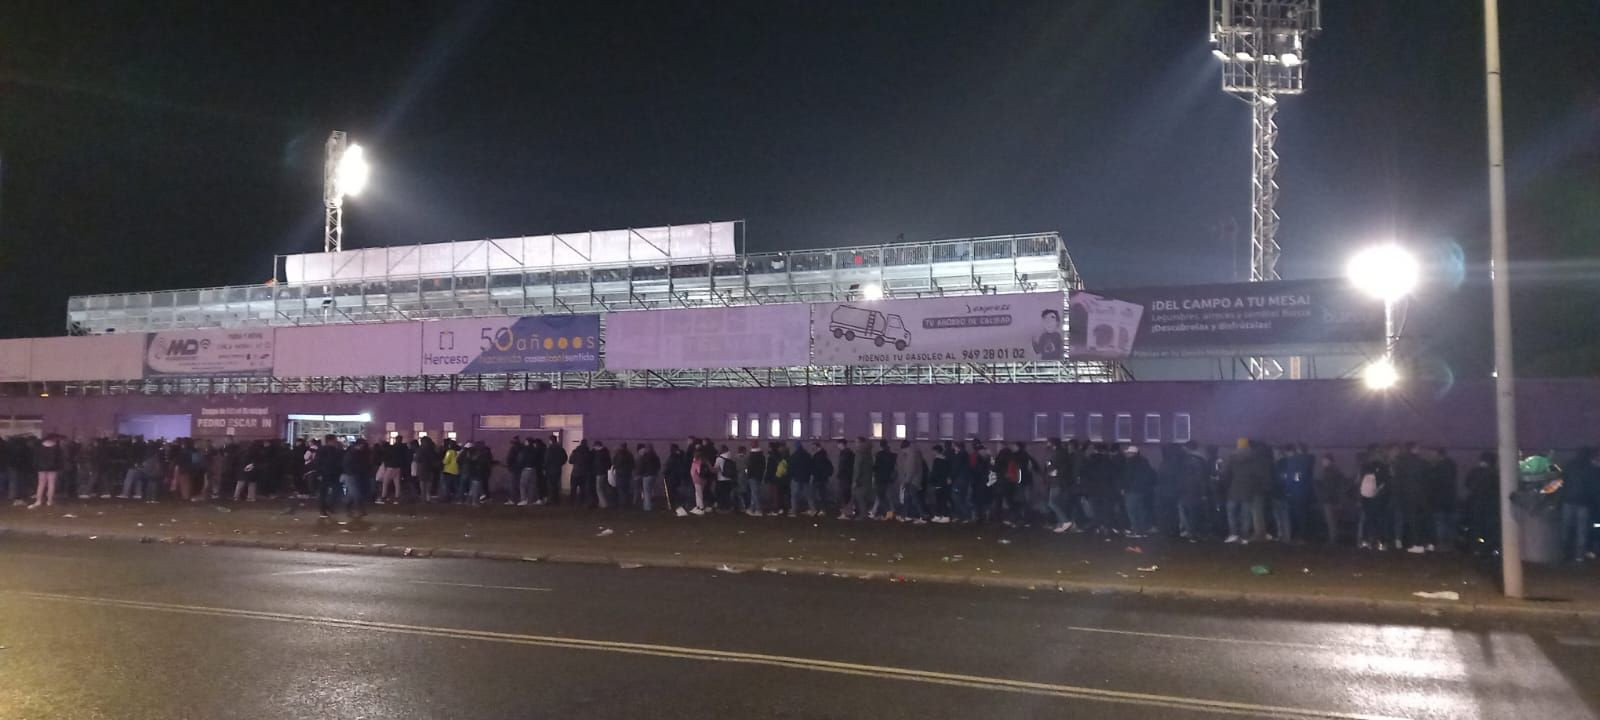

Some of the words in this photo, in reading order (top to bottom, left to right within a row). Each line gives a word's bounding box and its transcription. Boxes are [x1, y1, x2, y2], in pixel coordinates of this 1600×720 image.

[1183, 298, 1231, 310] CAMPO
[1233, 297, 1245, 308] A
[1247, 296, 1265, 308] TU
[1267, 294, 1311, 306] MESA!
[480, 327, 513, 352] 50
[424, 353, 469, 365] Hercesa
[945, 352, 956, 360] AL
[982, 348, 995, 359] 28
[997, 348, 1009, 360] 01
[1012, 348, 1025, 359] 02
[197, 418, 226, 428] PEDRO
